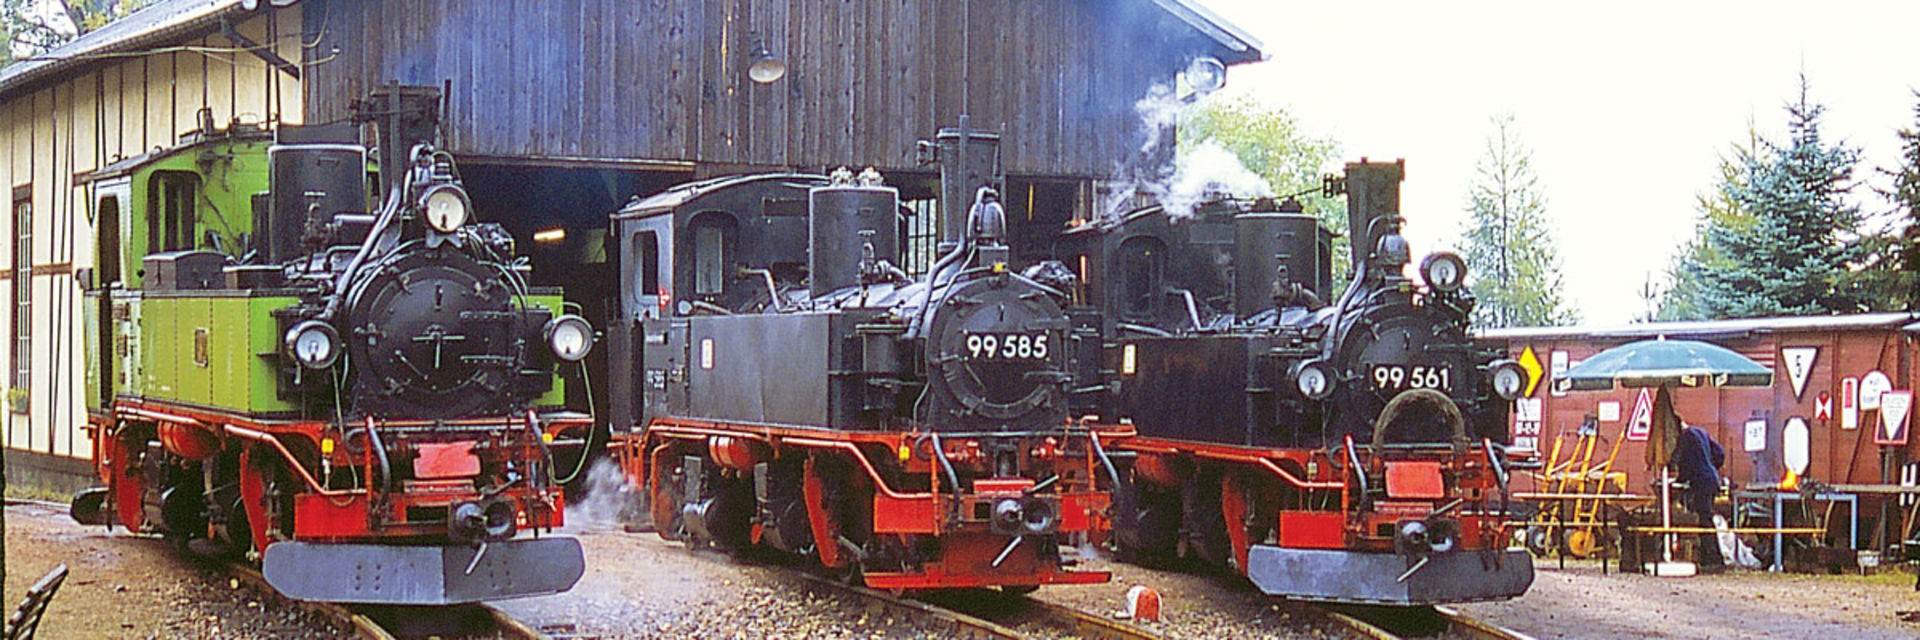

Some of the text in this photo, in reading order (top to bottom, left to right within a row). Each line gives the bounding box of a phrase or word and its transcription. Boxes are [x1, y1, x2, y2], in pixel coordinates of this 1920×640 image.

[967, 335, 1048, 358] 99 585
[1374, 366, 1449, 389] 99 561
[1795, 354, 1802, 378] 5
